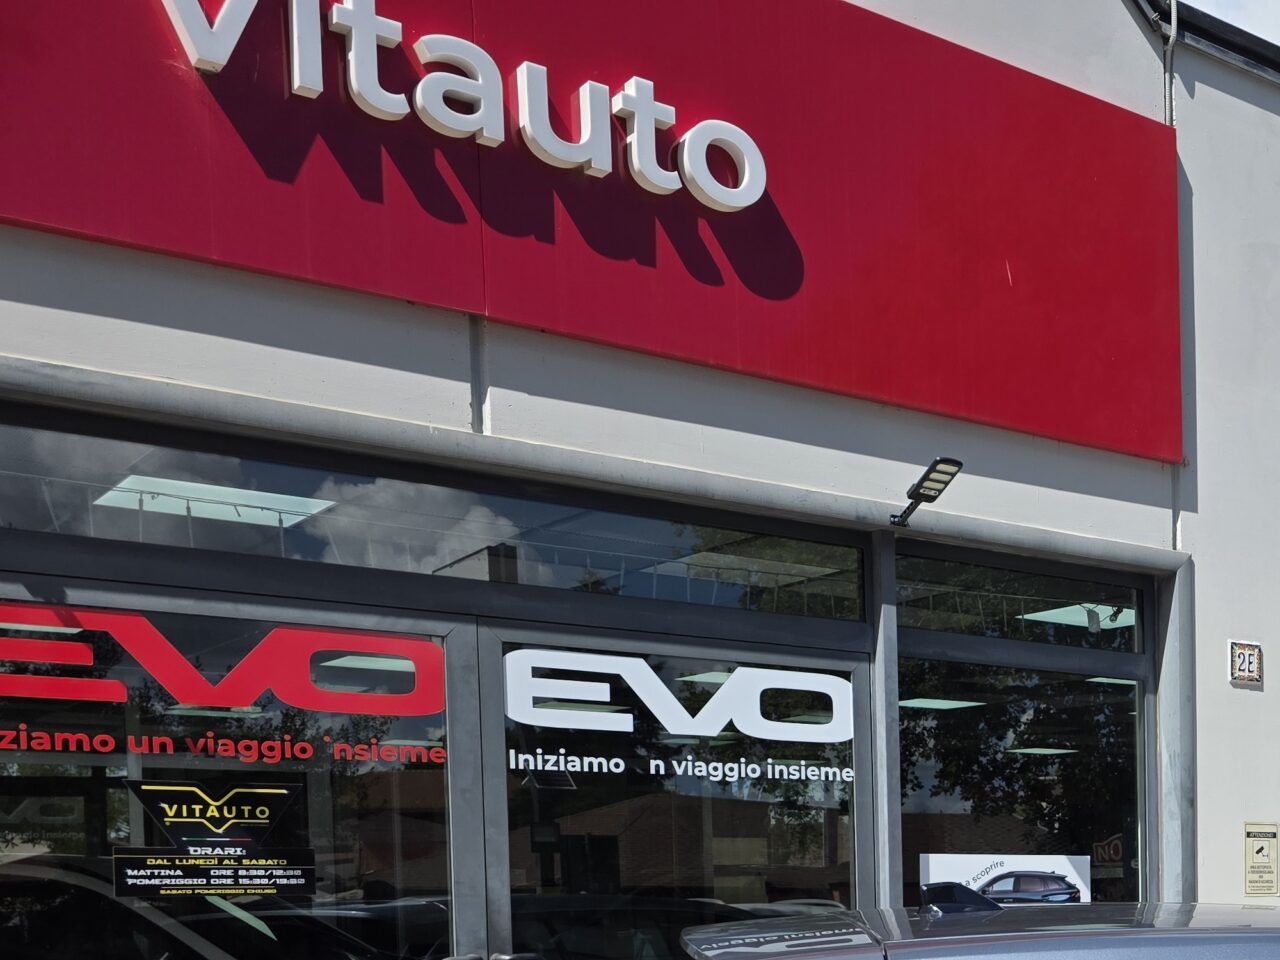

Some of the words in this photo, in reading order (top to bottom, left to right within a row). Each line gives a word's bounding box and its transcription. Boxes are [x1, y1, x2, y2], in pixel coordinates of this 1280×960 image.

[0, 604, 445, 717] EVO
[1237, 651, 1255, 673] 2E
[503, 649, 854, 744] EVO
[127, 735, 174, 754] un
[185, 731, 313, 764] viaggio
[323, 735, 446, 764] nsieme
[508, 748, 626, 774] Iniziamo
[672, 755, 761, 783] viaggio
[767, 758, 854, 781] insieme
[164, 804, 270, 819] VITAUTO
[127, 869, 184, 877] MATTINA
[210, 869, 235, 877] ORE
[146, 858, 172, 866] DAL
[222, 858, 239, 866] AL
[242, 858, 288, 866] SABATO
[972, 860, 1005, 884] scoprire
[127, 878, 207, 886] POMERIGGIO
[210, 878, 235, 886] ORE
